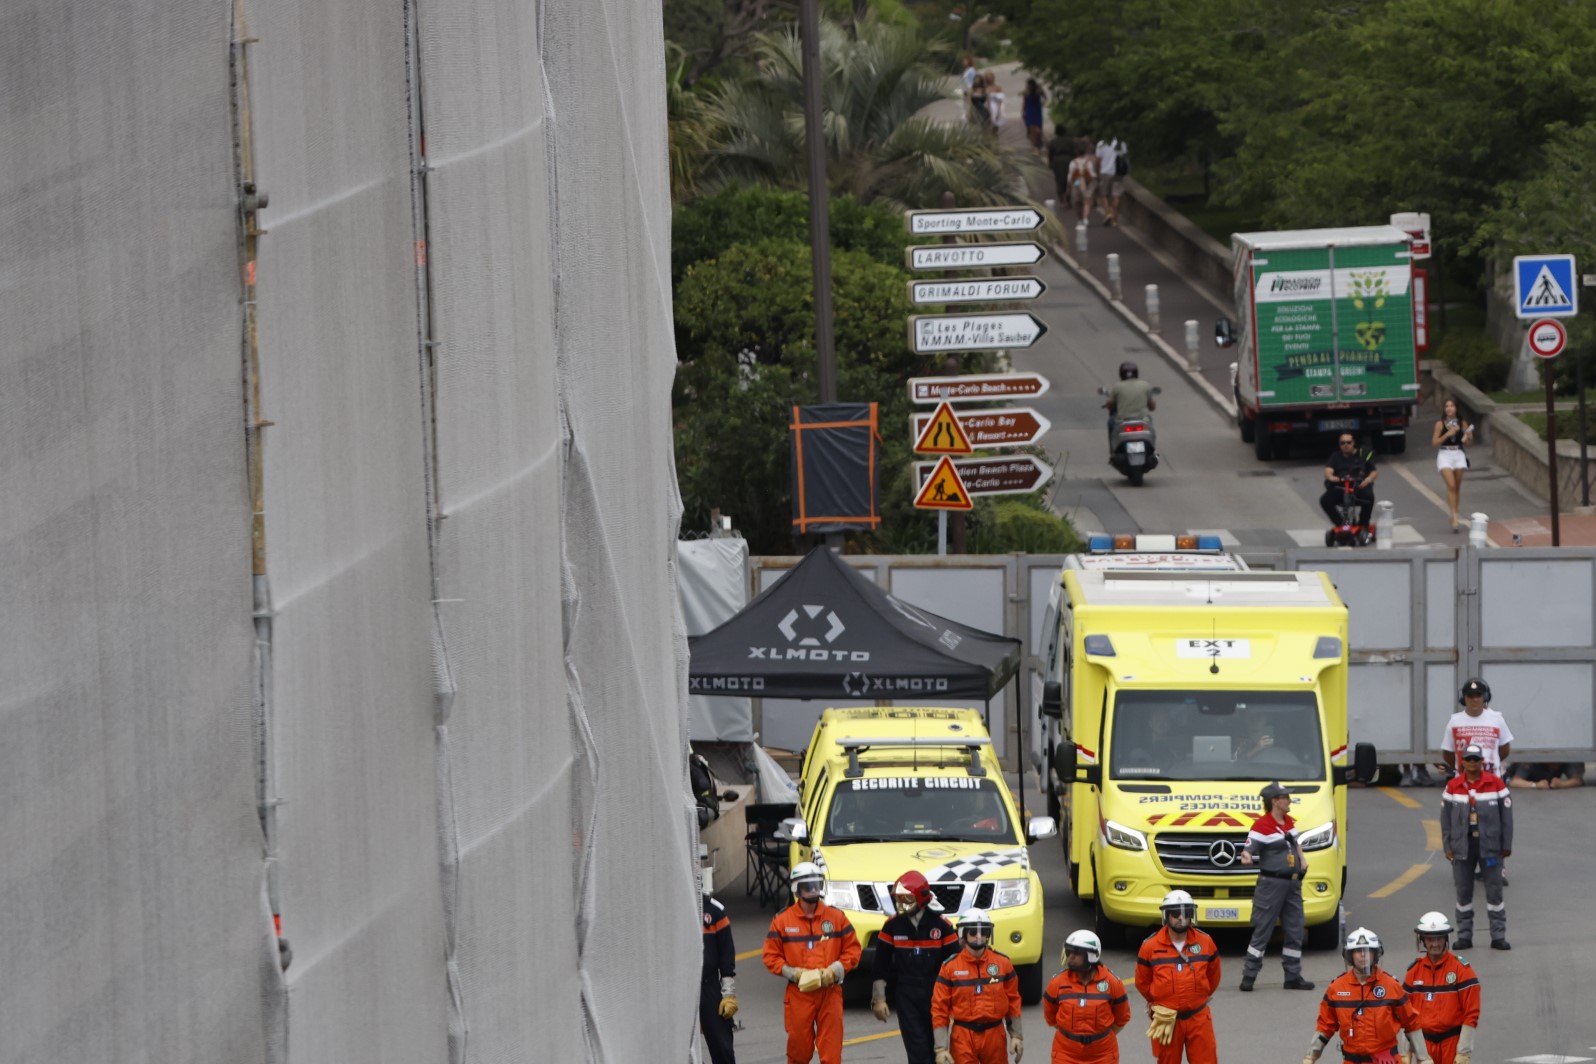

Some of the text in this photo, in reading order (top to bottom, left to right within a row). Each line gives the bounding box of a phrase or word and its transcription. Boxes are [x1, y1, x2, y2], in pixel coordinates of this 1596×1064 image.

[917, 215, 1032, 230] Sporting Monte-Carlo
[917, 250, 985, 265] LARVOTTO
[918, 283, 1031, 298] GRIMALDI FORUM
[938, 320, 1004, 333] Les Plages
[930, 384, 980, 396] Mote-Carlo
[1188, 640, 1237, 649] EXT
[748, 646, 871, 662] XLMOTO
[1207, 648, 1222, 657] 2
[690, 676, 765, 690] XLMOTO
[873, 676, 949, 691] XLMOTO
[852, 777, 982, 791] SECURITE CIRCUIT
[1212, 908, 1238, 918] 039N
